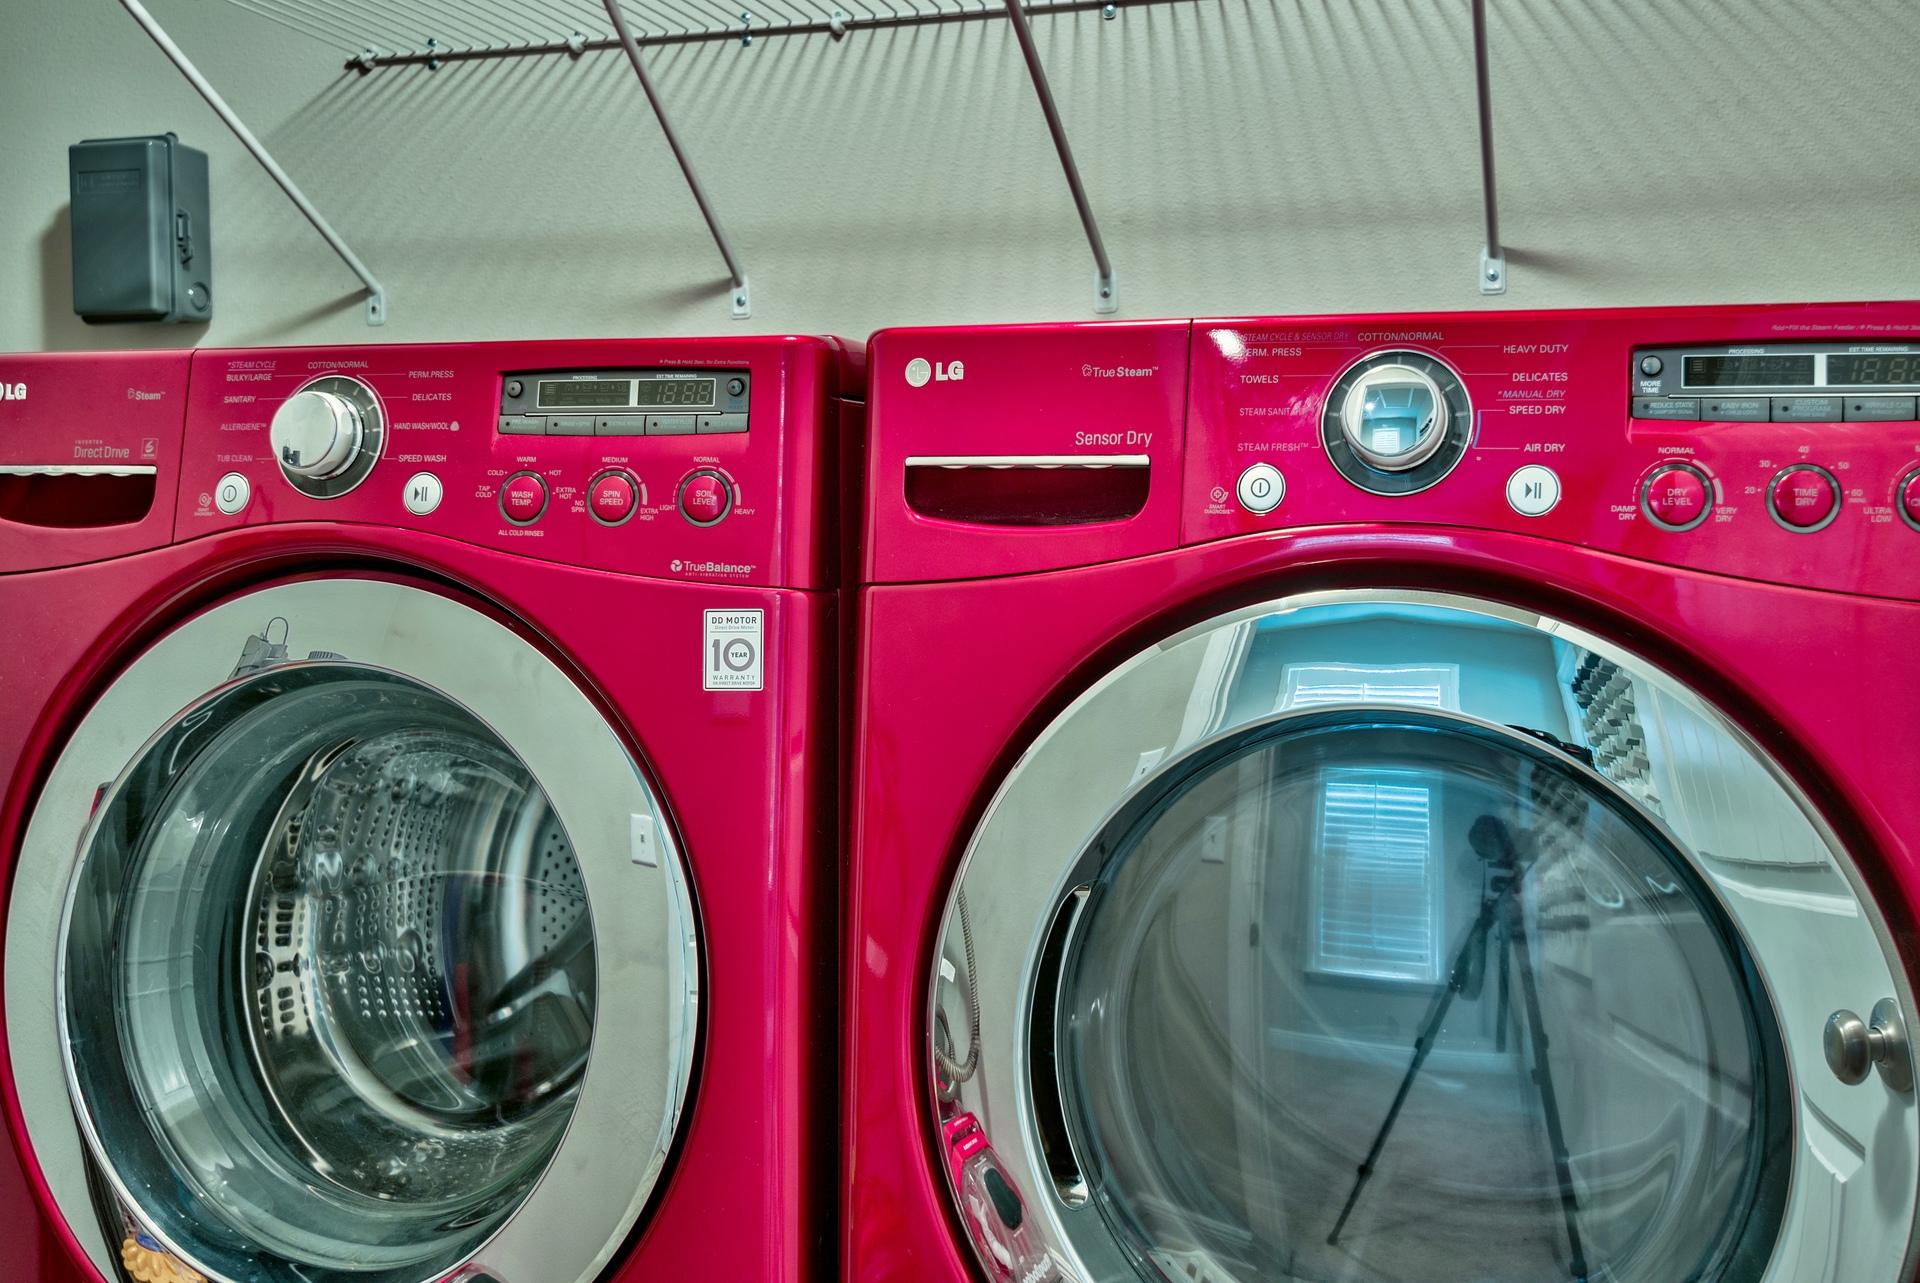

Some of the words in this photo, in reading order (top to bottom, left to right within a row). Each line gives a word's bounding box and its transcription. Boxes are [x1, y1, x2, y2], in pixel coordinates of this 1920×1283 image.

[1271, 333, 1293, 341] CYCLE
[1357, 331, 1445, 342] COTTON/NORMAL
[1244, 348, 1270, 357] ERM.
[1271, 347, 1302, 357] PRESS
[1503, 345, 1538, 354] HEAVY
[1539, 344, 1569, 354] DUTY
[307, 361, 368, 369] COTTON/NORMAL
[431, 370, 454, 378] PRESS
[935, 361, 964, 381] LG
[226, 373, 272, 381] BULKY/LARGE
[1240, 375, 1279, 383] TOWELS
[1512, 372, 1568, 382] DELICATES
[5, 383, 27, 400] LG
[1545, 389, 1566, 398] DRY
[412, 393, 452, 401] DELICATES
[1240, 408, 1266, 416] STEAM
[1508, 405, 1542, 415] SPEED
[1544, 405, 1567, 415] DRY
[1075, 431, 1123, 445] Sensor
[1127, 430, 1152, 447] Dry
[74, 446, 103, 458] Direct
[104, 446, 130, 458] Drive
[1237, 443, 1269, 452] STEAM
[1524, 443, 1541, 452] AIR
[1543, 443, 1565, 452] DRY
[1658, 446, 1695, 454] NORMAL
[602, 490, 621, 498] SPIN
[1667, 488, 1688, 497] DRY
[1744, 486, 1755, 494] 20
[1793, 488, 1818, 496] TIME
[599, 498, 624, 506] SPEED
[1662, 497, 1693, 506] LEVEL
[1795, 497, 1817, 506] DRY
[726, 616, 757, 624] MOTOR
[712, 637, 756, 672] 10
